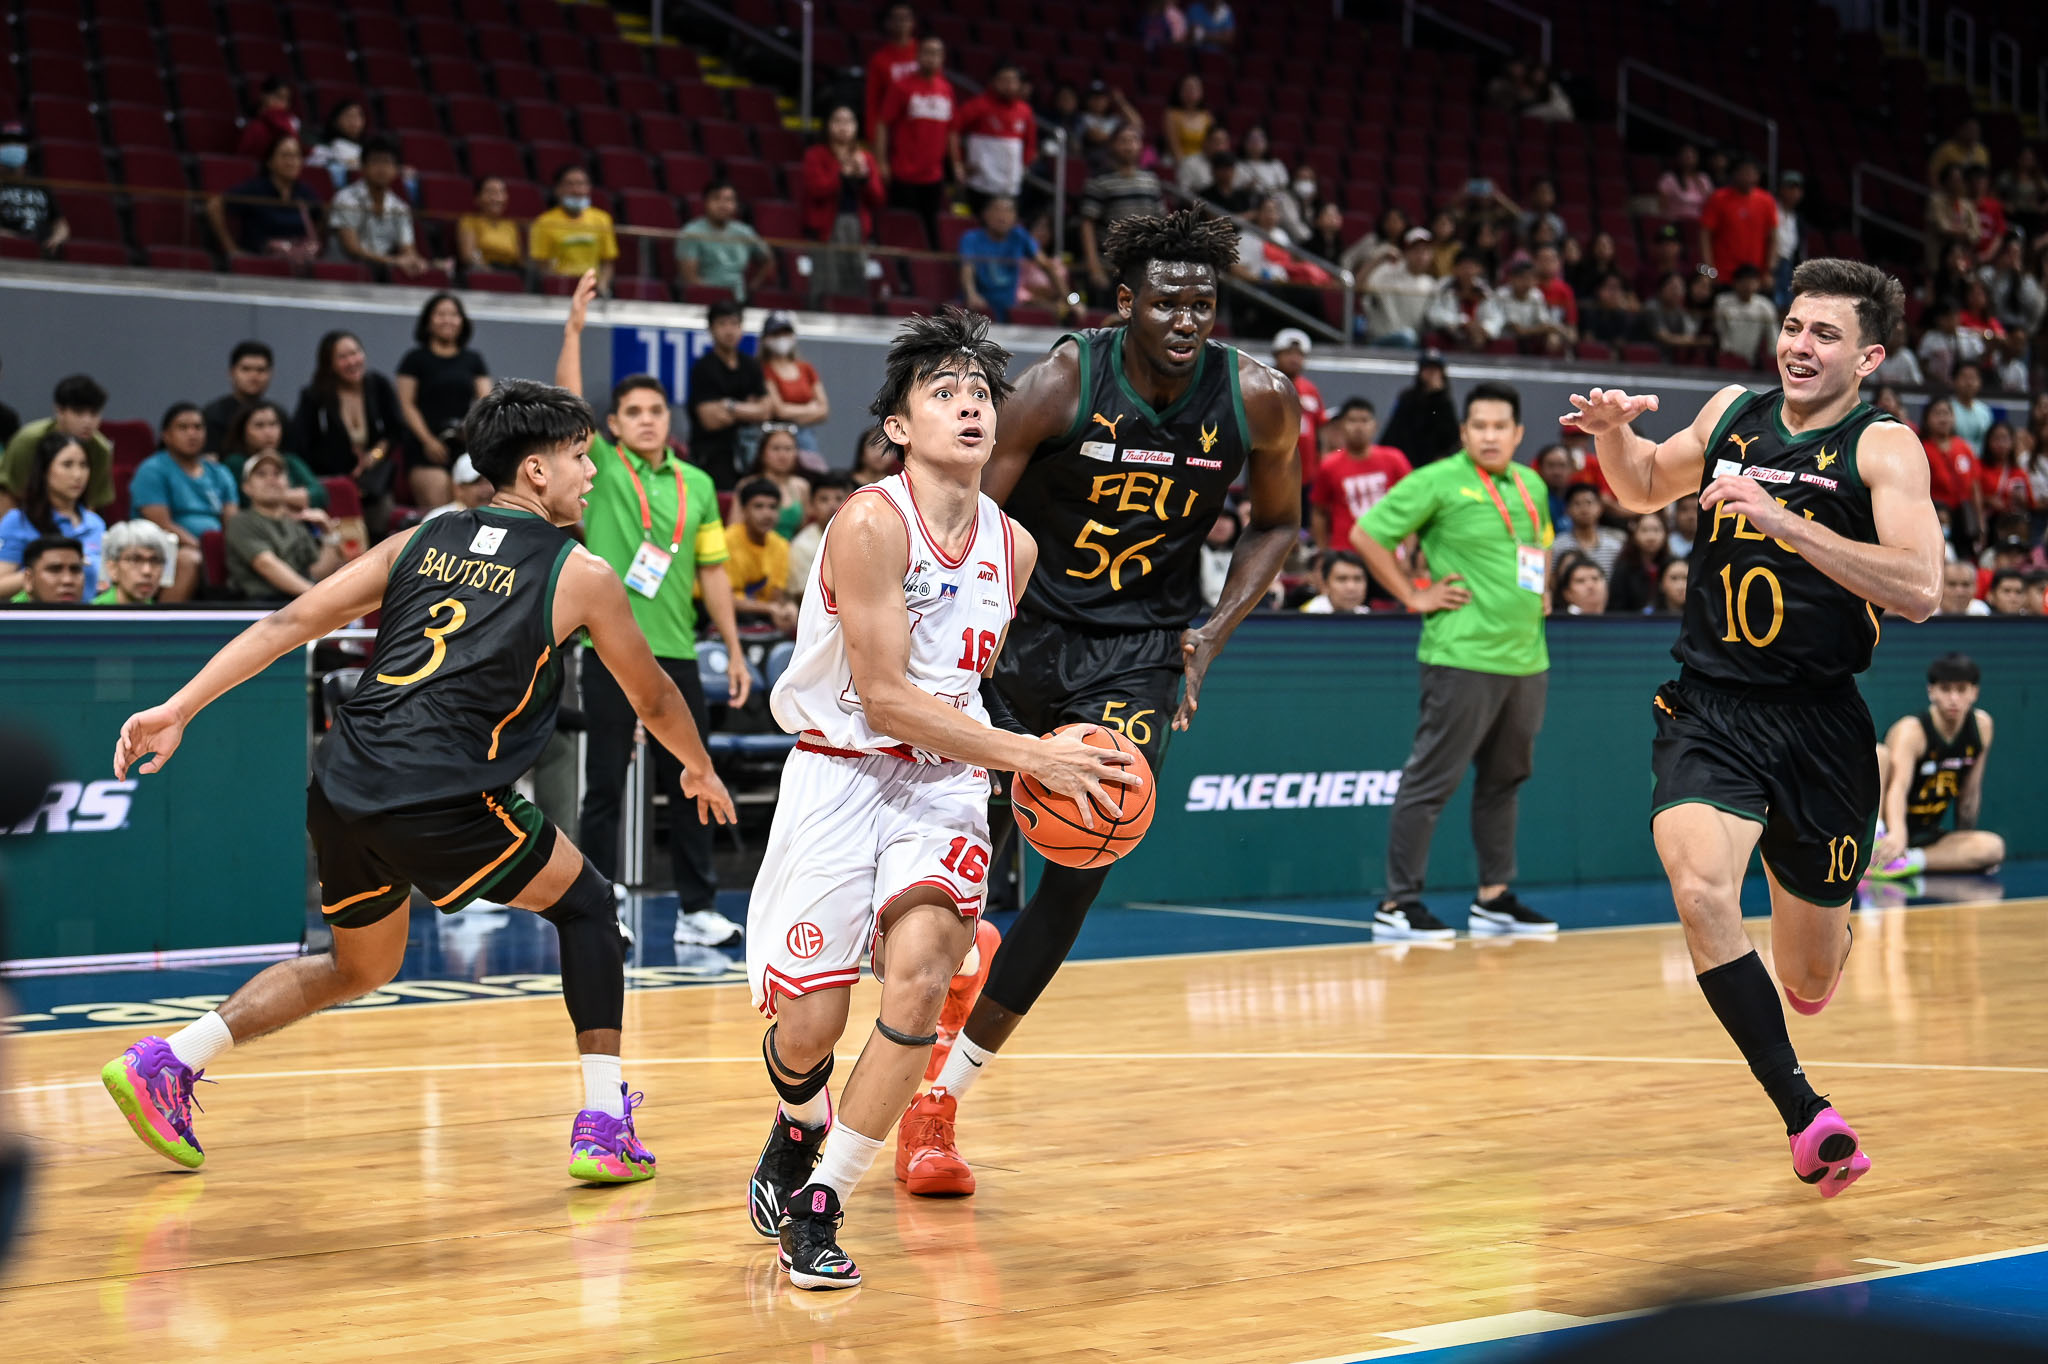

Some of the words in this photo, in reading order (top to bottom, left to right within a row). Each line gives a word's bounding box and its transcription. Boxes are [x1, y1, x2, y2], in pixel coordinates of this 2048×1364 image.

[1086, 471, 1199, 521] FEU
[417, 547, 516, 597] BAUTISTA
[977, 570, 994, 582] ANTA
[1065, 519, 1166, 591] 56
[1720, 563, 1784, 648] 10
[376, 597, 467, 685] 3
[957, 627, 996, 674] 16
[1102, 701, 1156, 745] 56
[0, 780, 138, 834] RS
[940, 836, 989, 884] 16
[1824, 835, 1858, 883] 10
